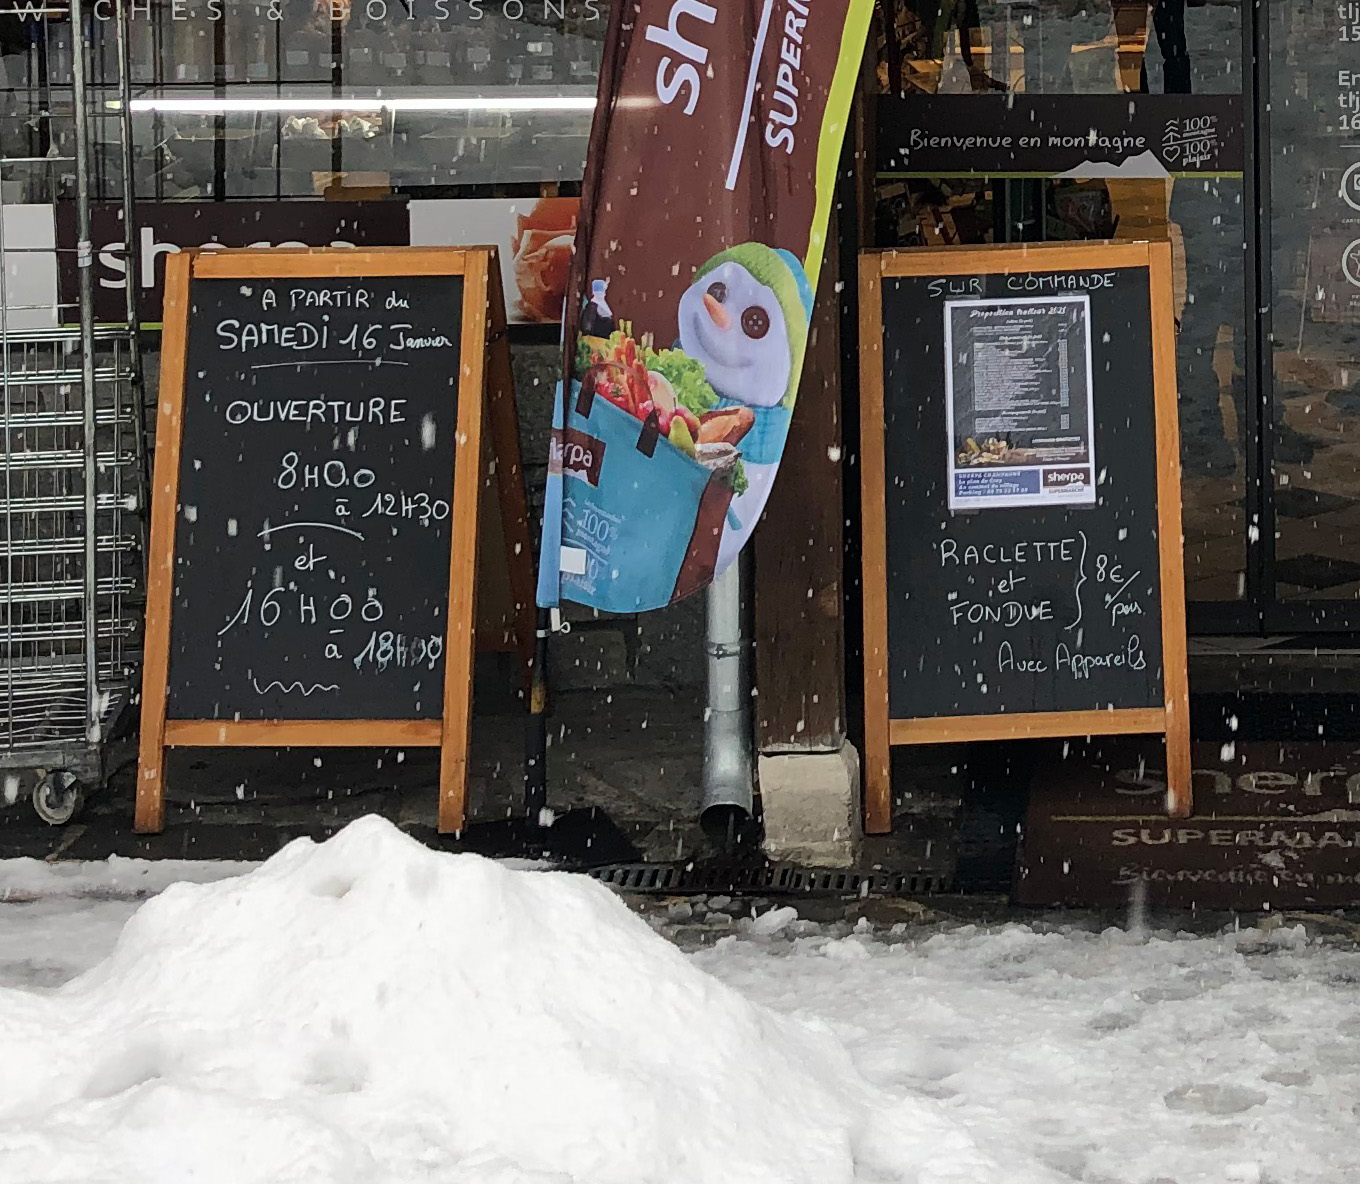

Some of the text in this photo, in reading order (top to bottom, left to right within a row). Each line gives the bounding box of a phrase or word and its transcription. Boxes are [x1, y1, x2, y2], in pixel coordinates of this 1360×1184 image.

[266, 0, 284, 22] &
[910, 128, 1147, 154] Bienvenue en montagne
[926, 272, 1116, 298] SUR COMMANDE
[261, 288, 277, 310] A
[385, 290, 410, 310] du
[339, 323, 382, 350] 16
[388, 323, 453, 350] Janvier
[225, 397, 408, 425] OUVERTURE
[1047, 471, 1085, 483] sherpa
[361, 492, 450, 520] 12H30
[294, 543, 328, 572] et
[939, 538, 1076, 567] RACLETTE
[997, 570, 1027, 594] et
[949, 600, 1055, 627] FONDUE
[997, 634, 1147, 680] Avec Appareils
